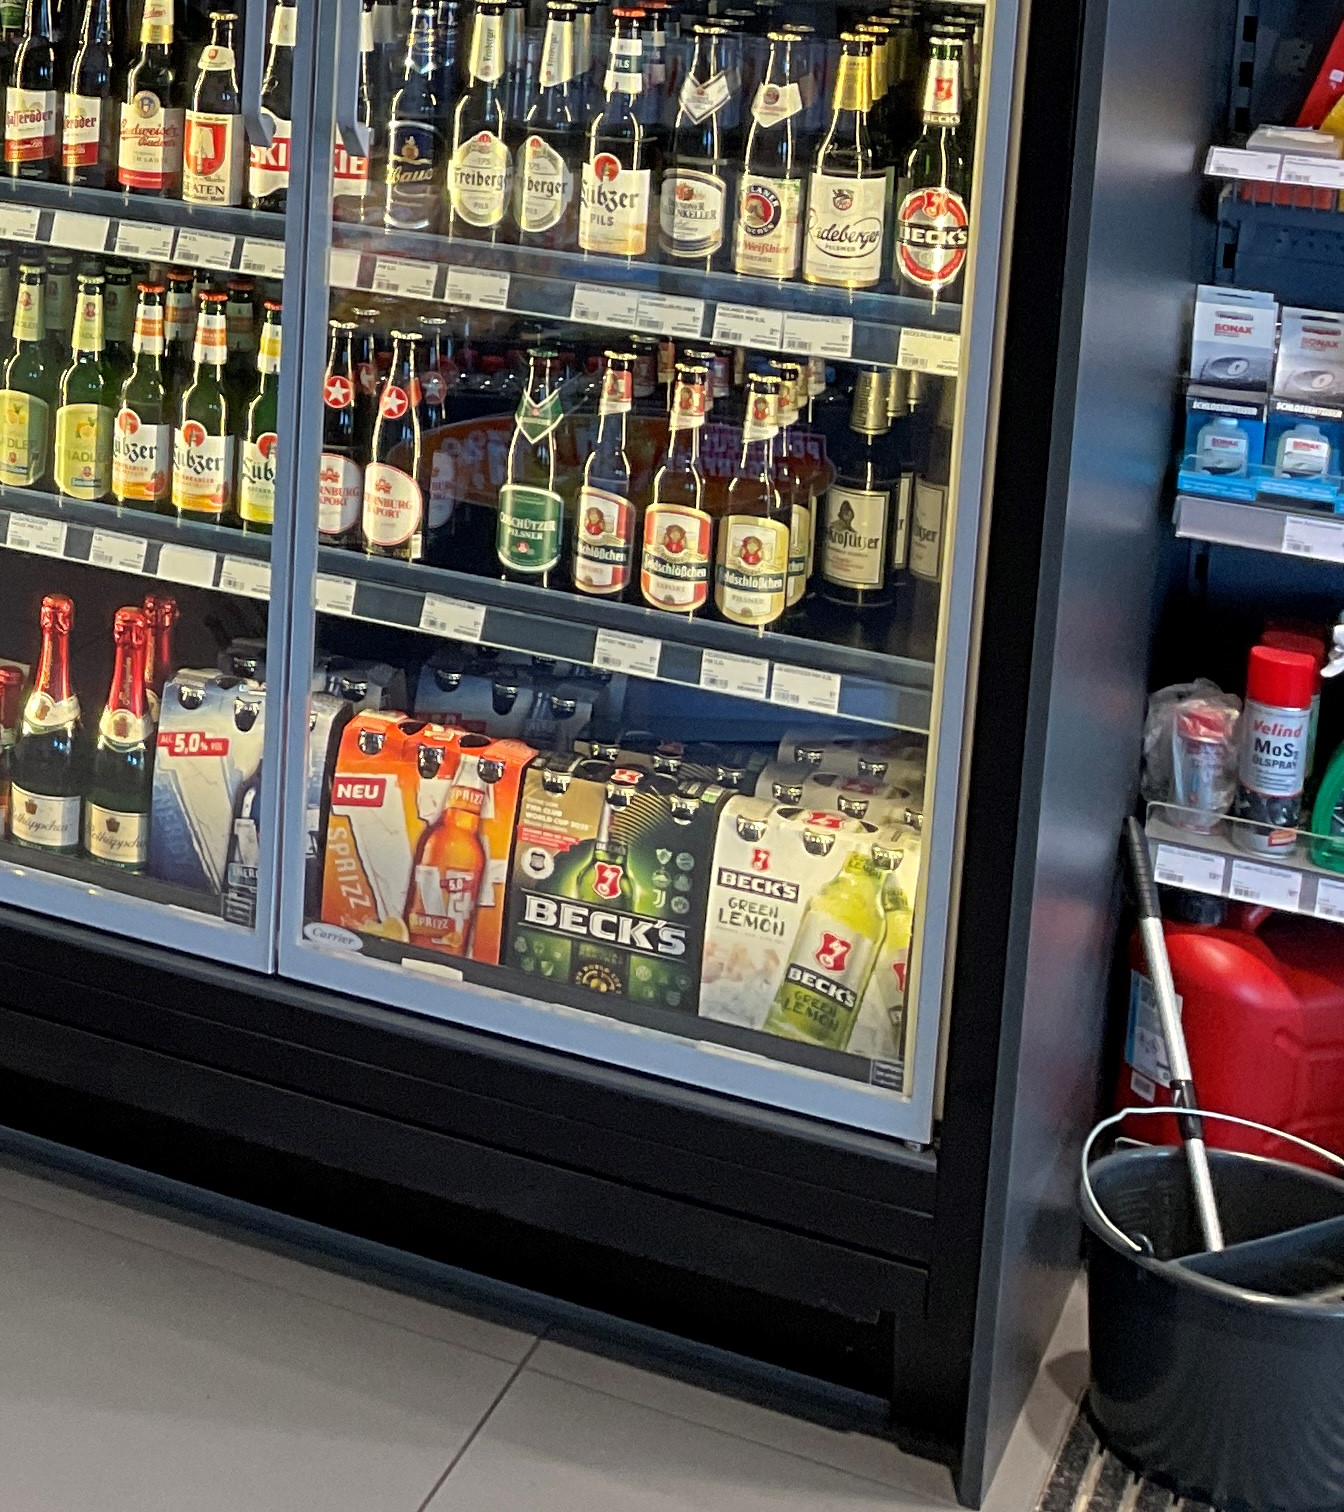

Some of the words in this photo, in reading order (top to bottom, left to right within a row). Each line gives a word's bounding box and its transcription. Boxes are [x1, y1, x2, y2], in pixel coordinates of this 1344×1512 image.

[589, 212, 614, 226] PILS
[1215, 324, 1253, 335] SONAX
[1301, 337, 1340, 350] SONAX
[1212, 437, 1239, 448] SONAX
[509, 528, 544, 540] PILSNER
[1253, 719, 1303, 739] Velind
[337, 784, 379, 800] NEU
[525, 812, 551, 823] WORLD
[553, 817, 569, 827] CUP
[544, 808, 562, 817] CLUB
[329, 826, 372, 909] SPRIZZ
[720, 871, 798, 900] BECK'S
[728, 896, 779, 919] GREEN
[412, 916, 450, 931] SPRIZZ
[524, 894, 687, 956] BECK'S
[718, 907, 785, 937] LEMON
[313, 925, 354, 945] Carrier
[788, 966, 855, 1009] BECK'S
[782, 996, 840, 1029] LEMON
[794, 990, 838, 1017] GREEN
